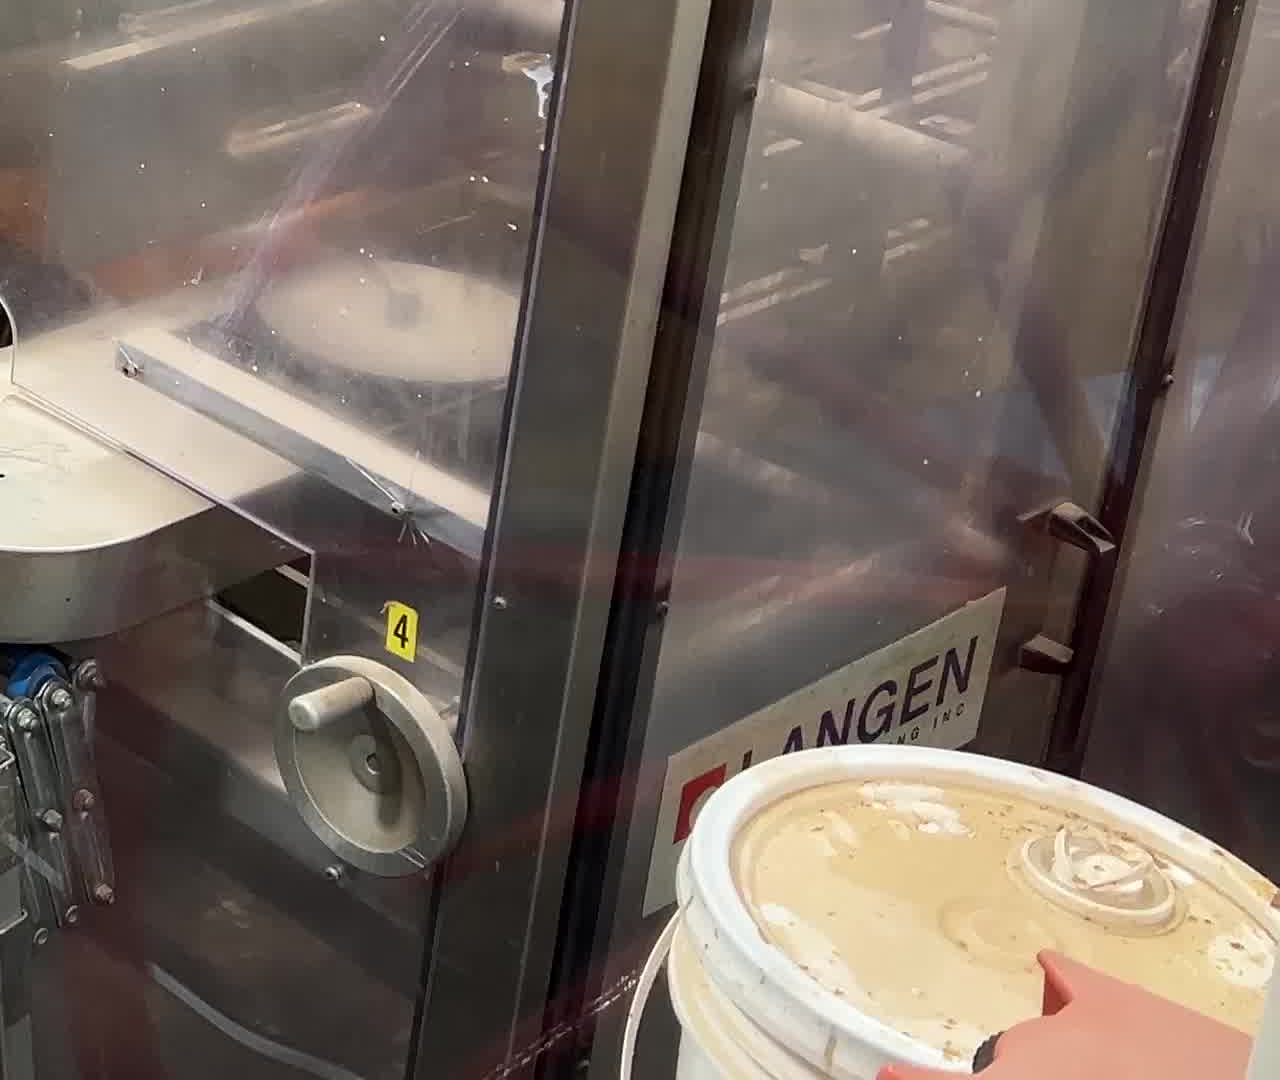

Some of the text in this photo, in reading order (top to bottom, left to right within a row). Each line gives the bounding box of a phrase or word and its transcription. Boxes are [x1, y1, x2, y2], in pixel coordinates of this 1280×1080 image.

[393, 614, 409, 649] 4
[741, 635, 978, 770] ANGEN
[933, 703, 965, 729] INC
